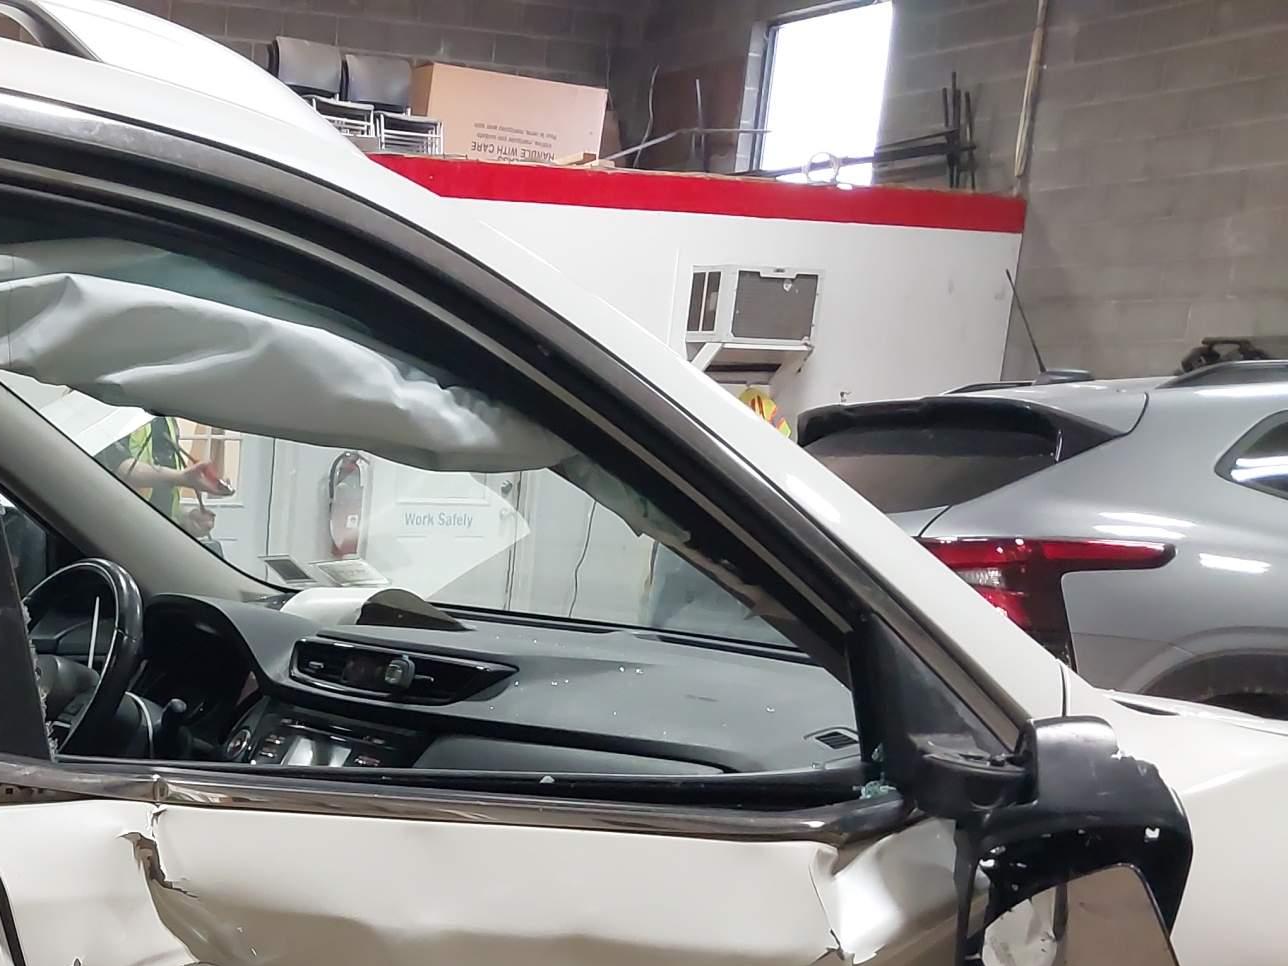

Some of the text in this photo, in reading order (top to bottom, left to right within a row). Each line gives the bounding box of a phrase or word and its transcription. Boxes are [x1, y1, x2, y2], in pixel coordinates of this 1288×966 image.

[471, 140, 495, 154] CARE
[497, 145, 518, 157] WITH
[520, 148, 555, 161] HANDLE
[404, 511, 473, 528] Work Safely
